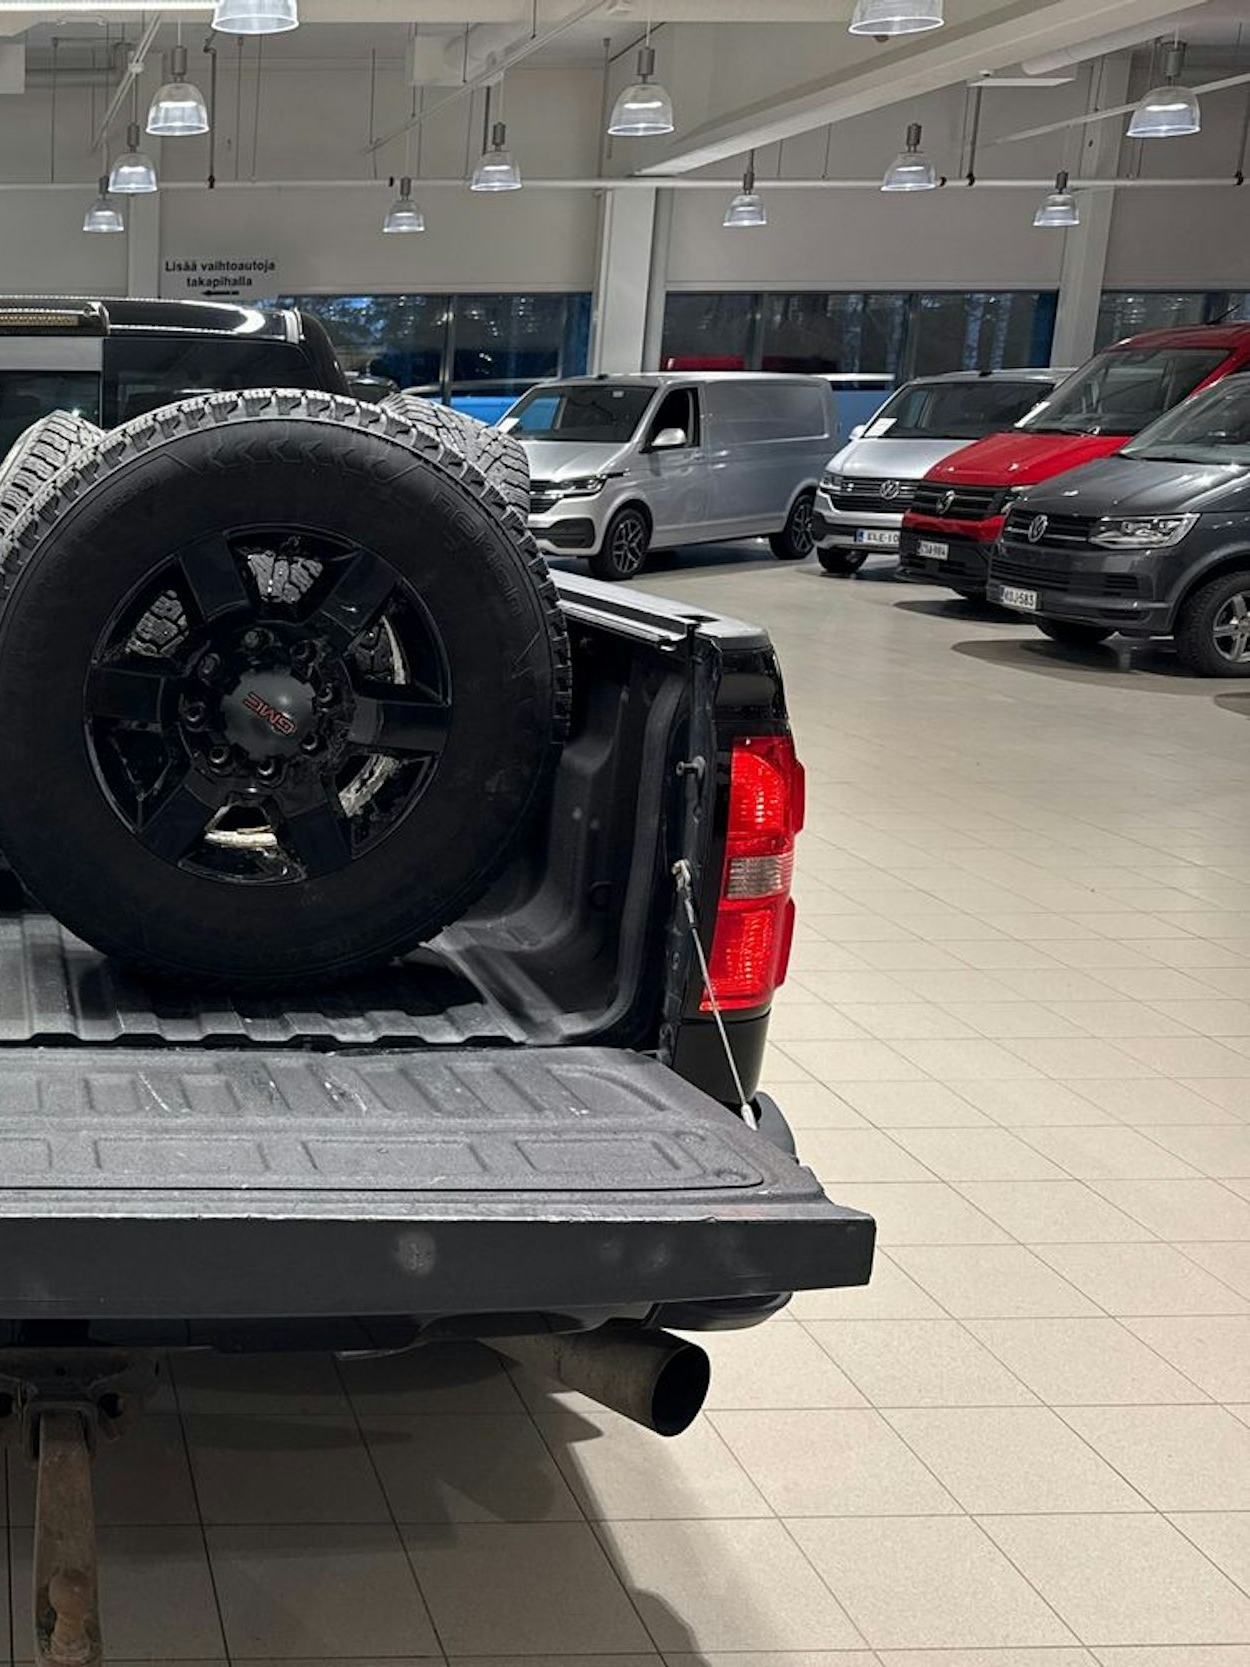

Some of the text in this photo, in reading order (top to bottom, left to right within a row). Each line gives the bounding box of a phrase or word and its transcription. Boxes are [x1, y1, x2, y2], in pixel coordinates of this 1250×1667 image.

[165, 260, 276, 273] Lisää vaihtoautoja
[187, 276, 253, 288] takapihalla
[243, 691, 297, 736] GMC
